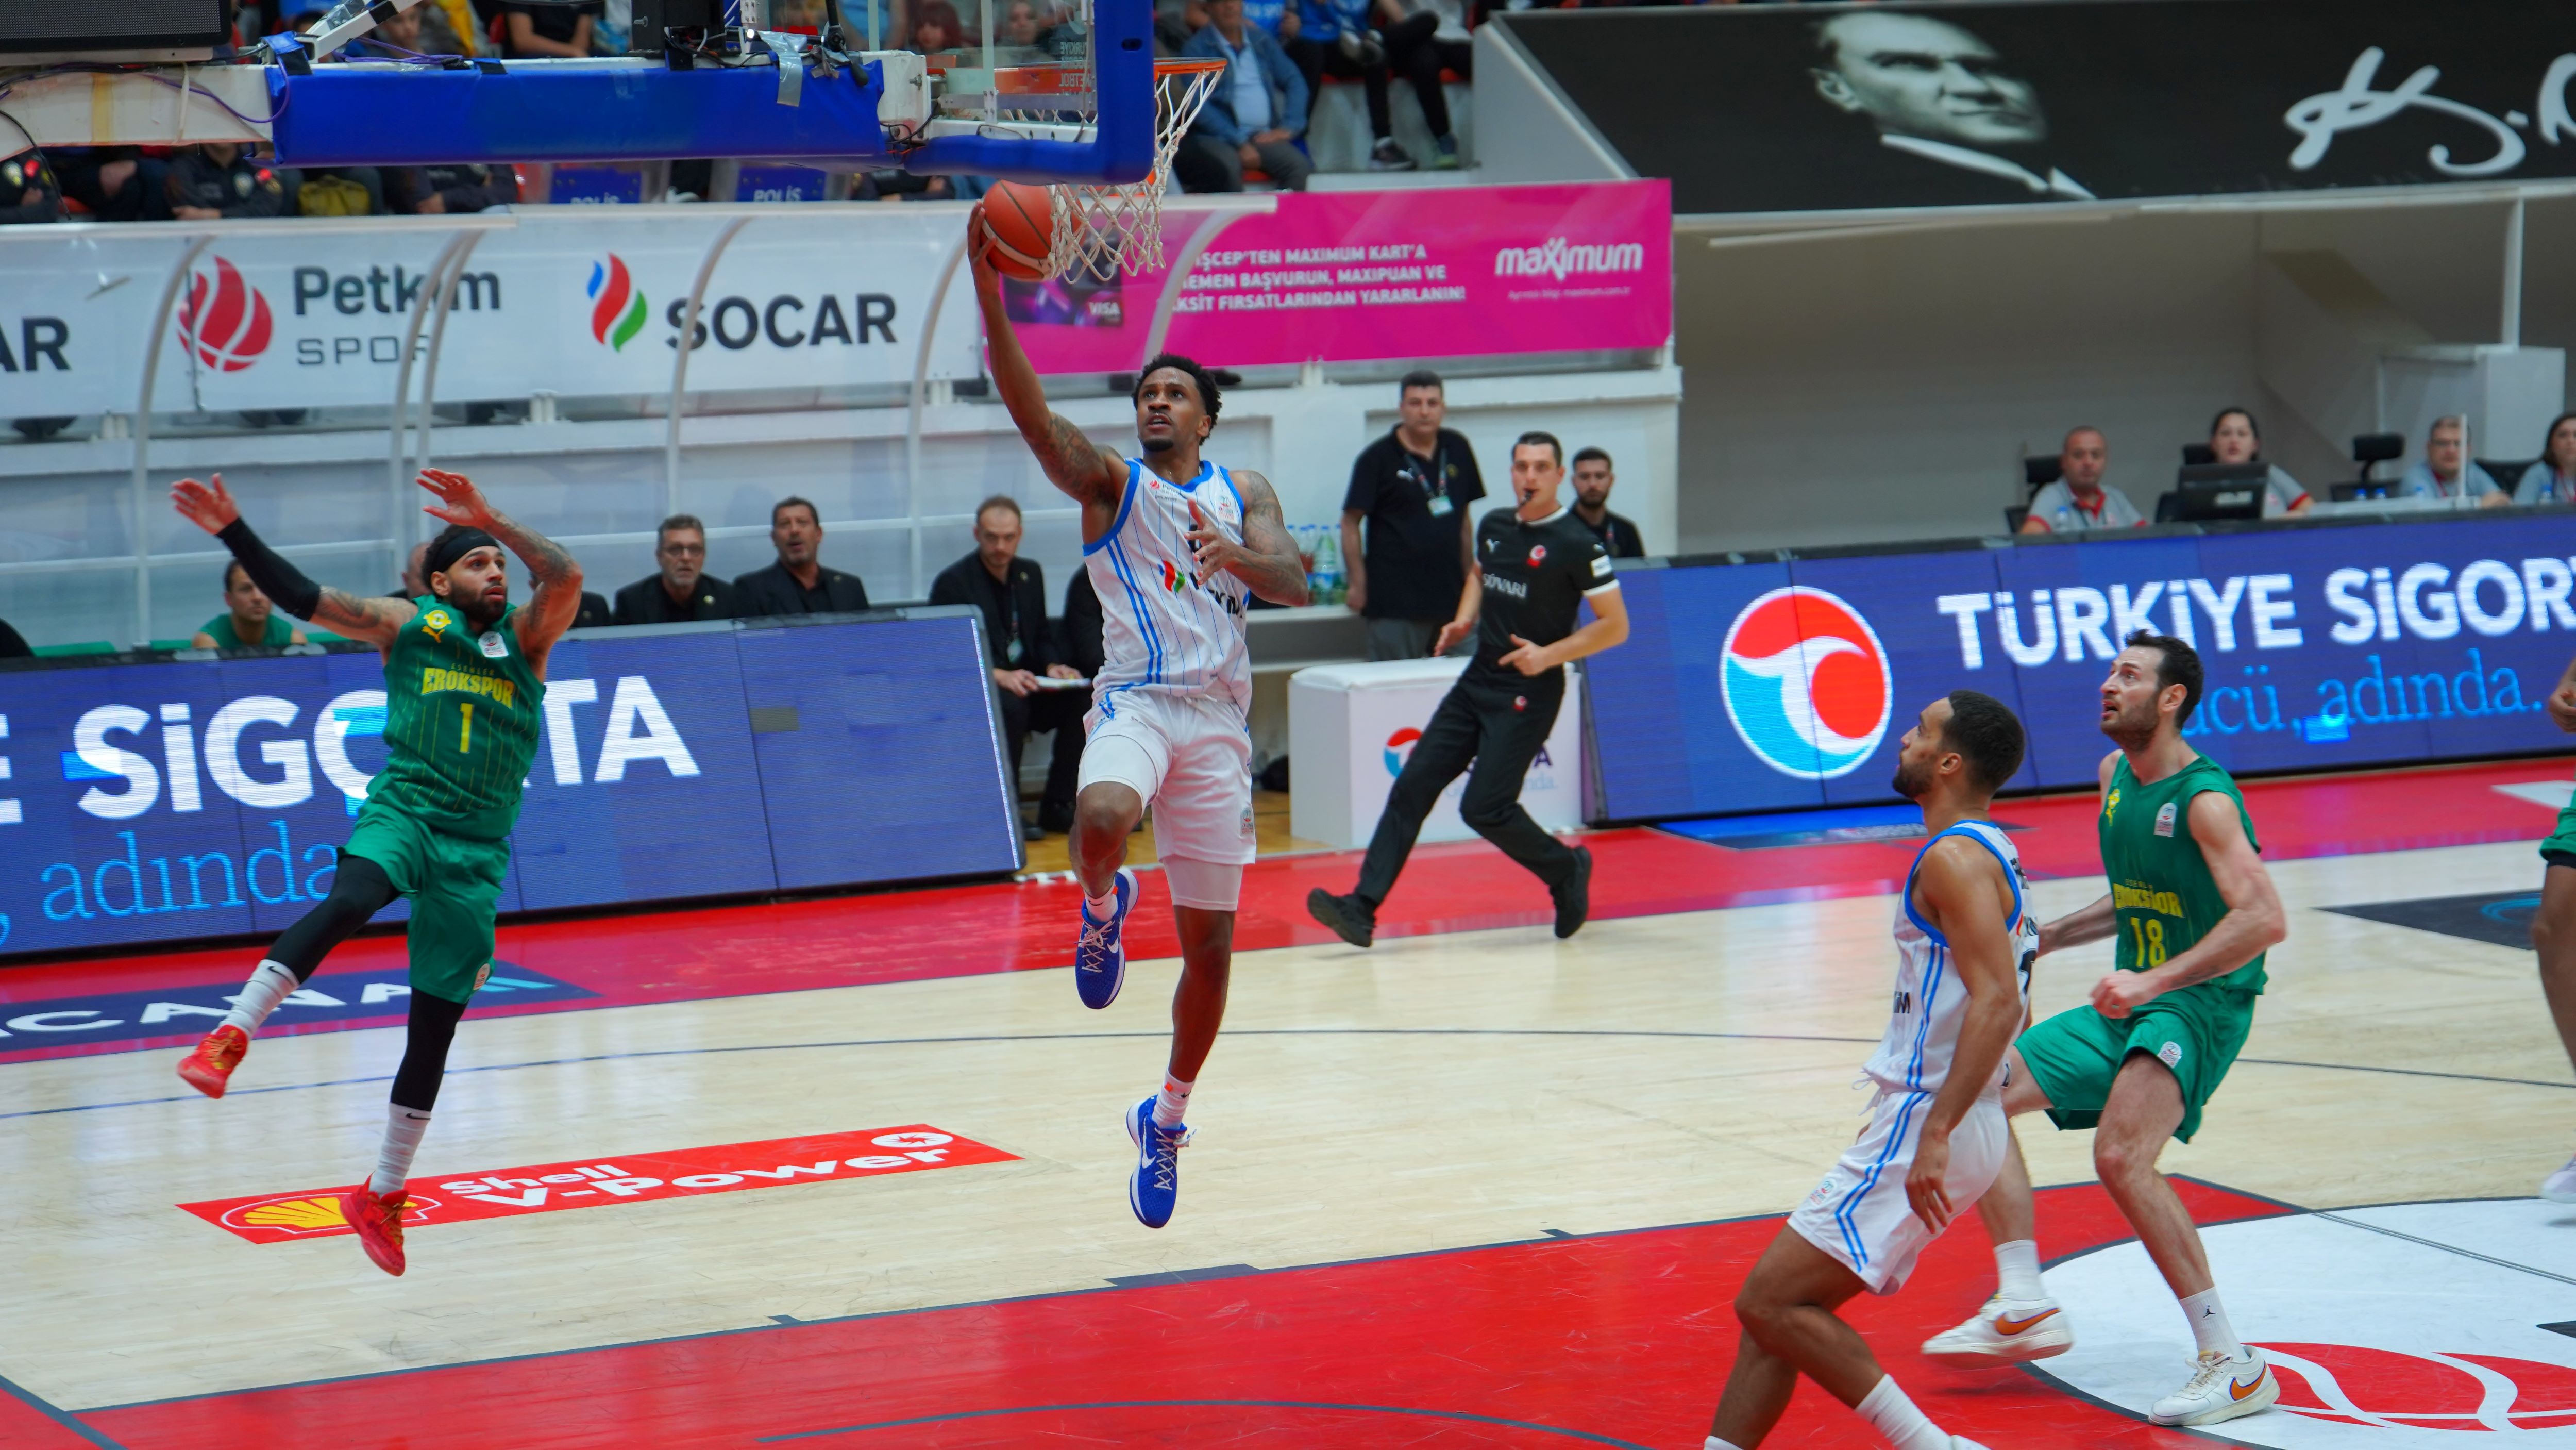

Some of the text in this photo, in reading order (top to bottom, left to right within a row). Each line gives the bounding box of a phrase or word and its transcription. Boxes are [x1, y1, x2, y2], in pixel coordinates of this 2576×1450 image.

[1183, 264, 1446, 291] EMEN BAŞVURUN, MAXIPUAN VE
[1196, 244, 1427, 272] ŞCEP'TEN MAXIMUM KART'A
[293, 263, 501, 316] Petkm
[1089, 302, 1121, 315] VISA
[1218, 290, 1357, 311] FIRSATLARINDAN
[665, 293, 898, 351] SOCAR
[420, 666, 515, 710] EROKSPOR
[460, 702, 474, 754] 1
[2130, 916, 2167, 969] 18
[439, 1164, 633, 1194] Shell
[461, 1148, 950, 1207] V-Power
